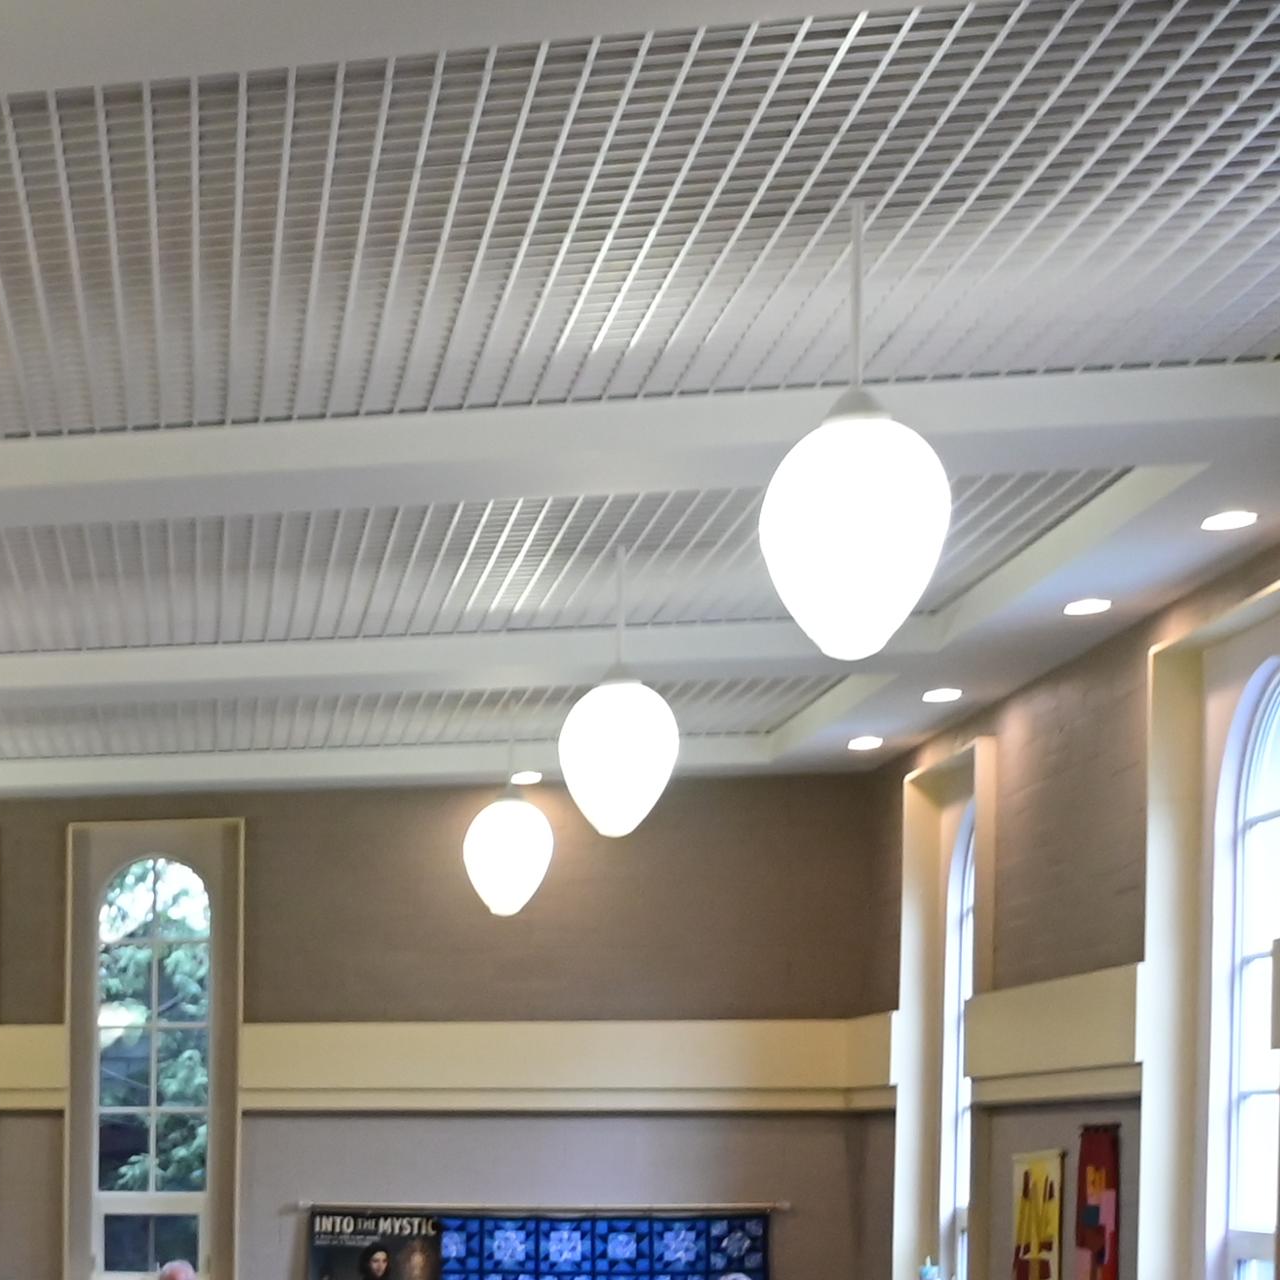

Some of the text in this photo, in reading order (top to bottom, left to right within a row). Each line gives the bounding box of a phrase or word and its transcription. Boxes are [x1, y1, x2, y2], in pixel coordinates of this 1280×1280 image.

[314, 1215, 437, 1236] INTO THE MYSTIC
